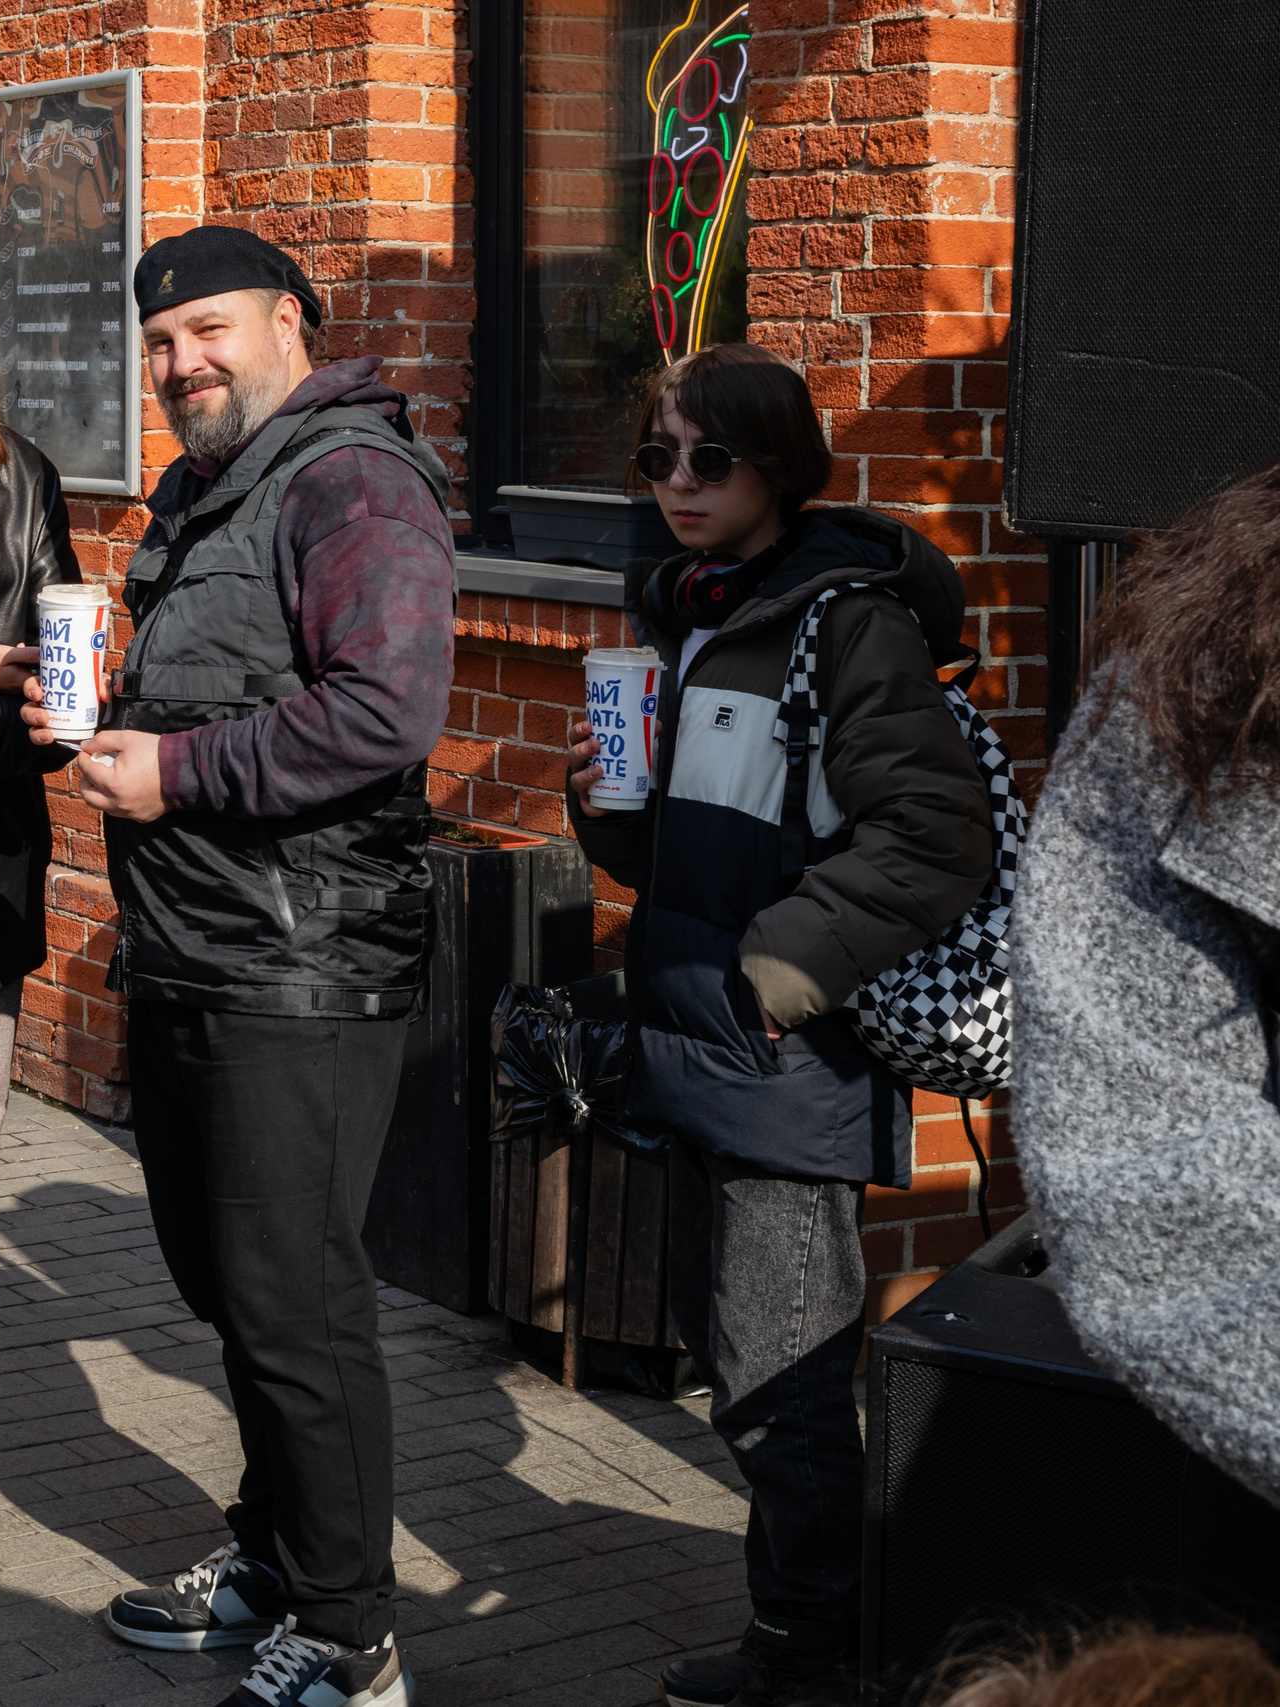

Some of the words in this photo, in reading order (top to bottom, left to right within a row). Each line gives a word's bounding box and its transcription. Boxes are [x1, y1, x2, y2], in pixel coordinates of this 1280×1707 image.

[26, 147, 52, 172] КОФЕ
[63, 144, 95, 165] СЭНДВИЧИ
[102, 282, 111, 292] 270
